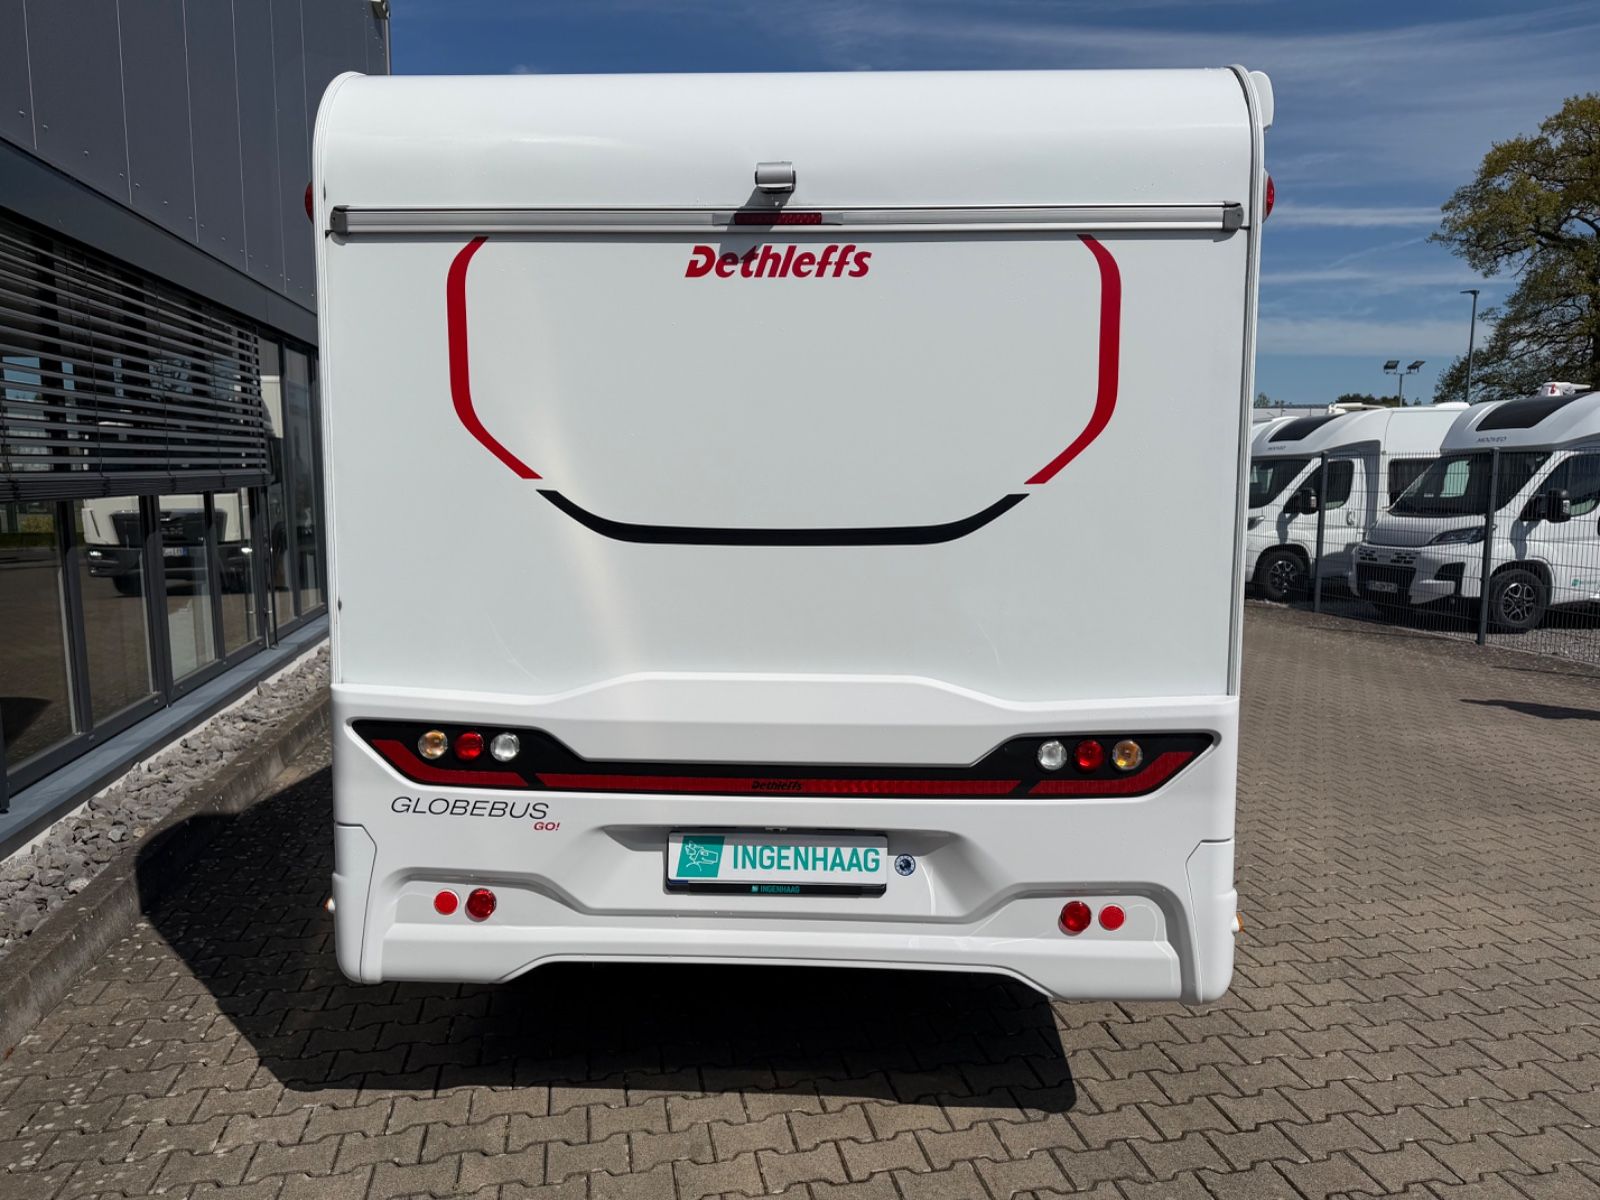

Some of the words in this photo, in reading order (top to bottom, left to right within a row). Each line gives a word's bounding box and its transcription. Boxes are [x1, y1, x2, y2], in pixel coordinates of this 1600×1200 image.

[685, 244, 872, 278] Dethleffs
[391, 796, 549, 820] GLOBEBUS
[533, 821, 561, 831] GO!
[733, 844, 880, 872] INGENHAAG
[760, 884, 800, 894] INGENHAAG
